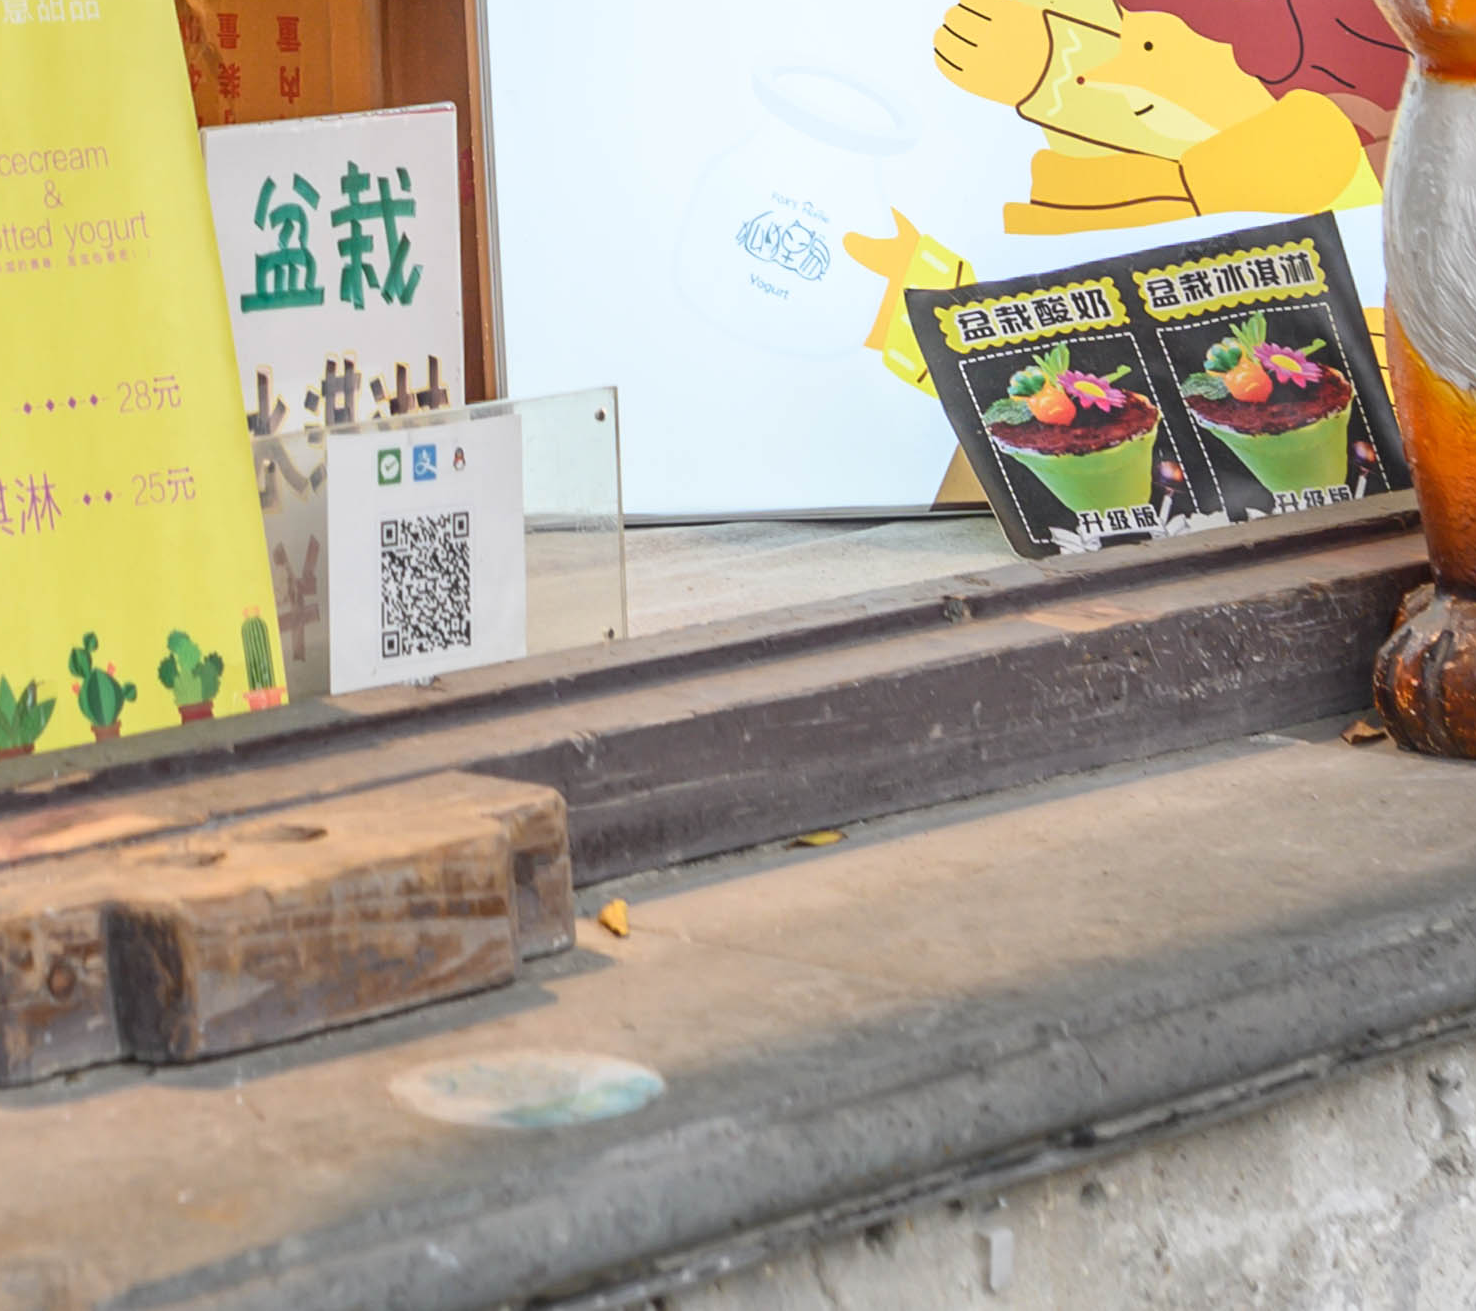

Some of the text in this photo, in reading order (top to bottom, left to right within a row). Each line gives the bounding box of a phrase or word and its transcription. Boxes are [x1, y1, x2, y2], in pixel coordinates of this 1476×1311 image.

[43, 180, 65, 209] &
[64, 211, 150, 253] yogurt
[240, 160, 424, 313] 盆栽
[1145, 250, 1317, 312] 盆栽冰淇淋
[956, 287, 1111, 343] 盆栽酸奶
[116, 374, 183, 416] 28元
[132, 465, 197, 508] 25元
[1275, 483, 1353, 515] 升级版
[1078, 503, 1159, 536] 升级版
